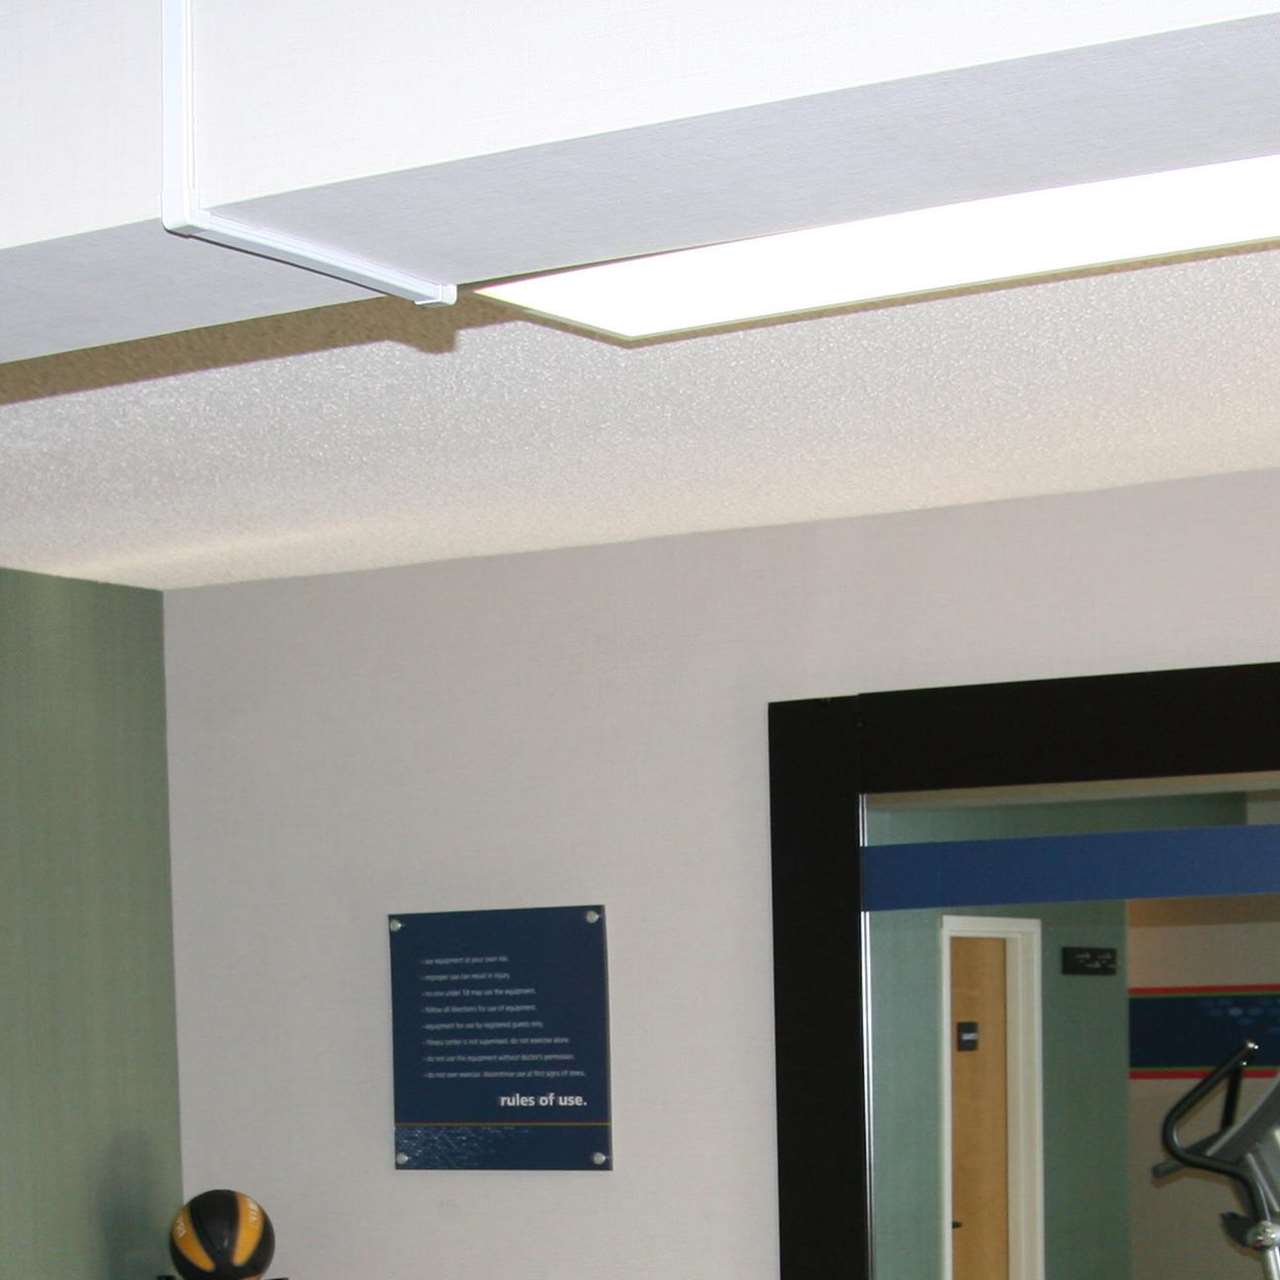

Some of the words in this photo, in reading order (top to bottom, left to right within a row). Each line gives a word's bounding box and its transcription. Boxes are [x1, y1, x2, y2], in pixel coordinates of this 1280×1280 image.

[500, 1093, 535, 1106] rules
[539, 1092, 555, 1106] of
[558, 1094, 588, 1106] use.
